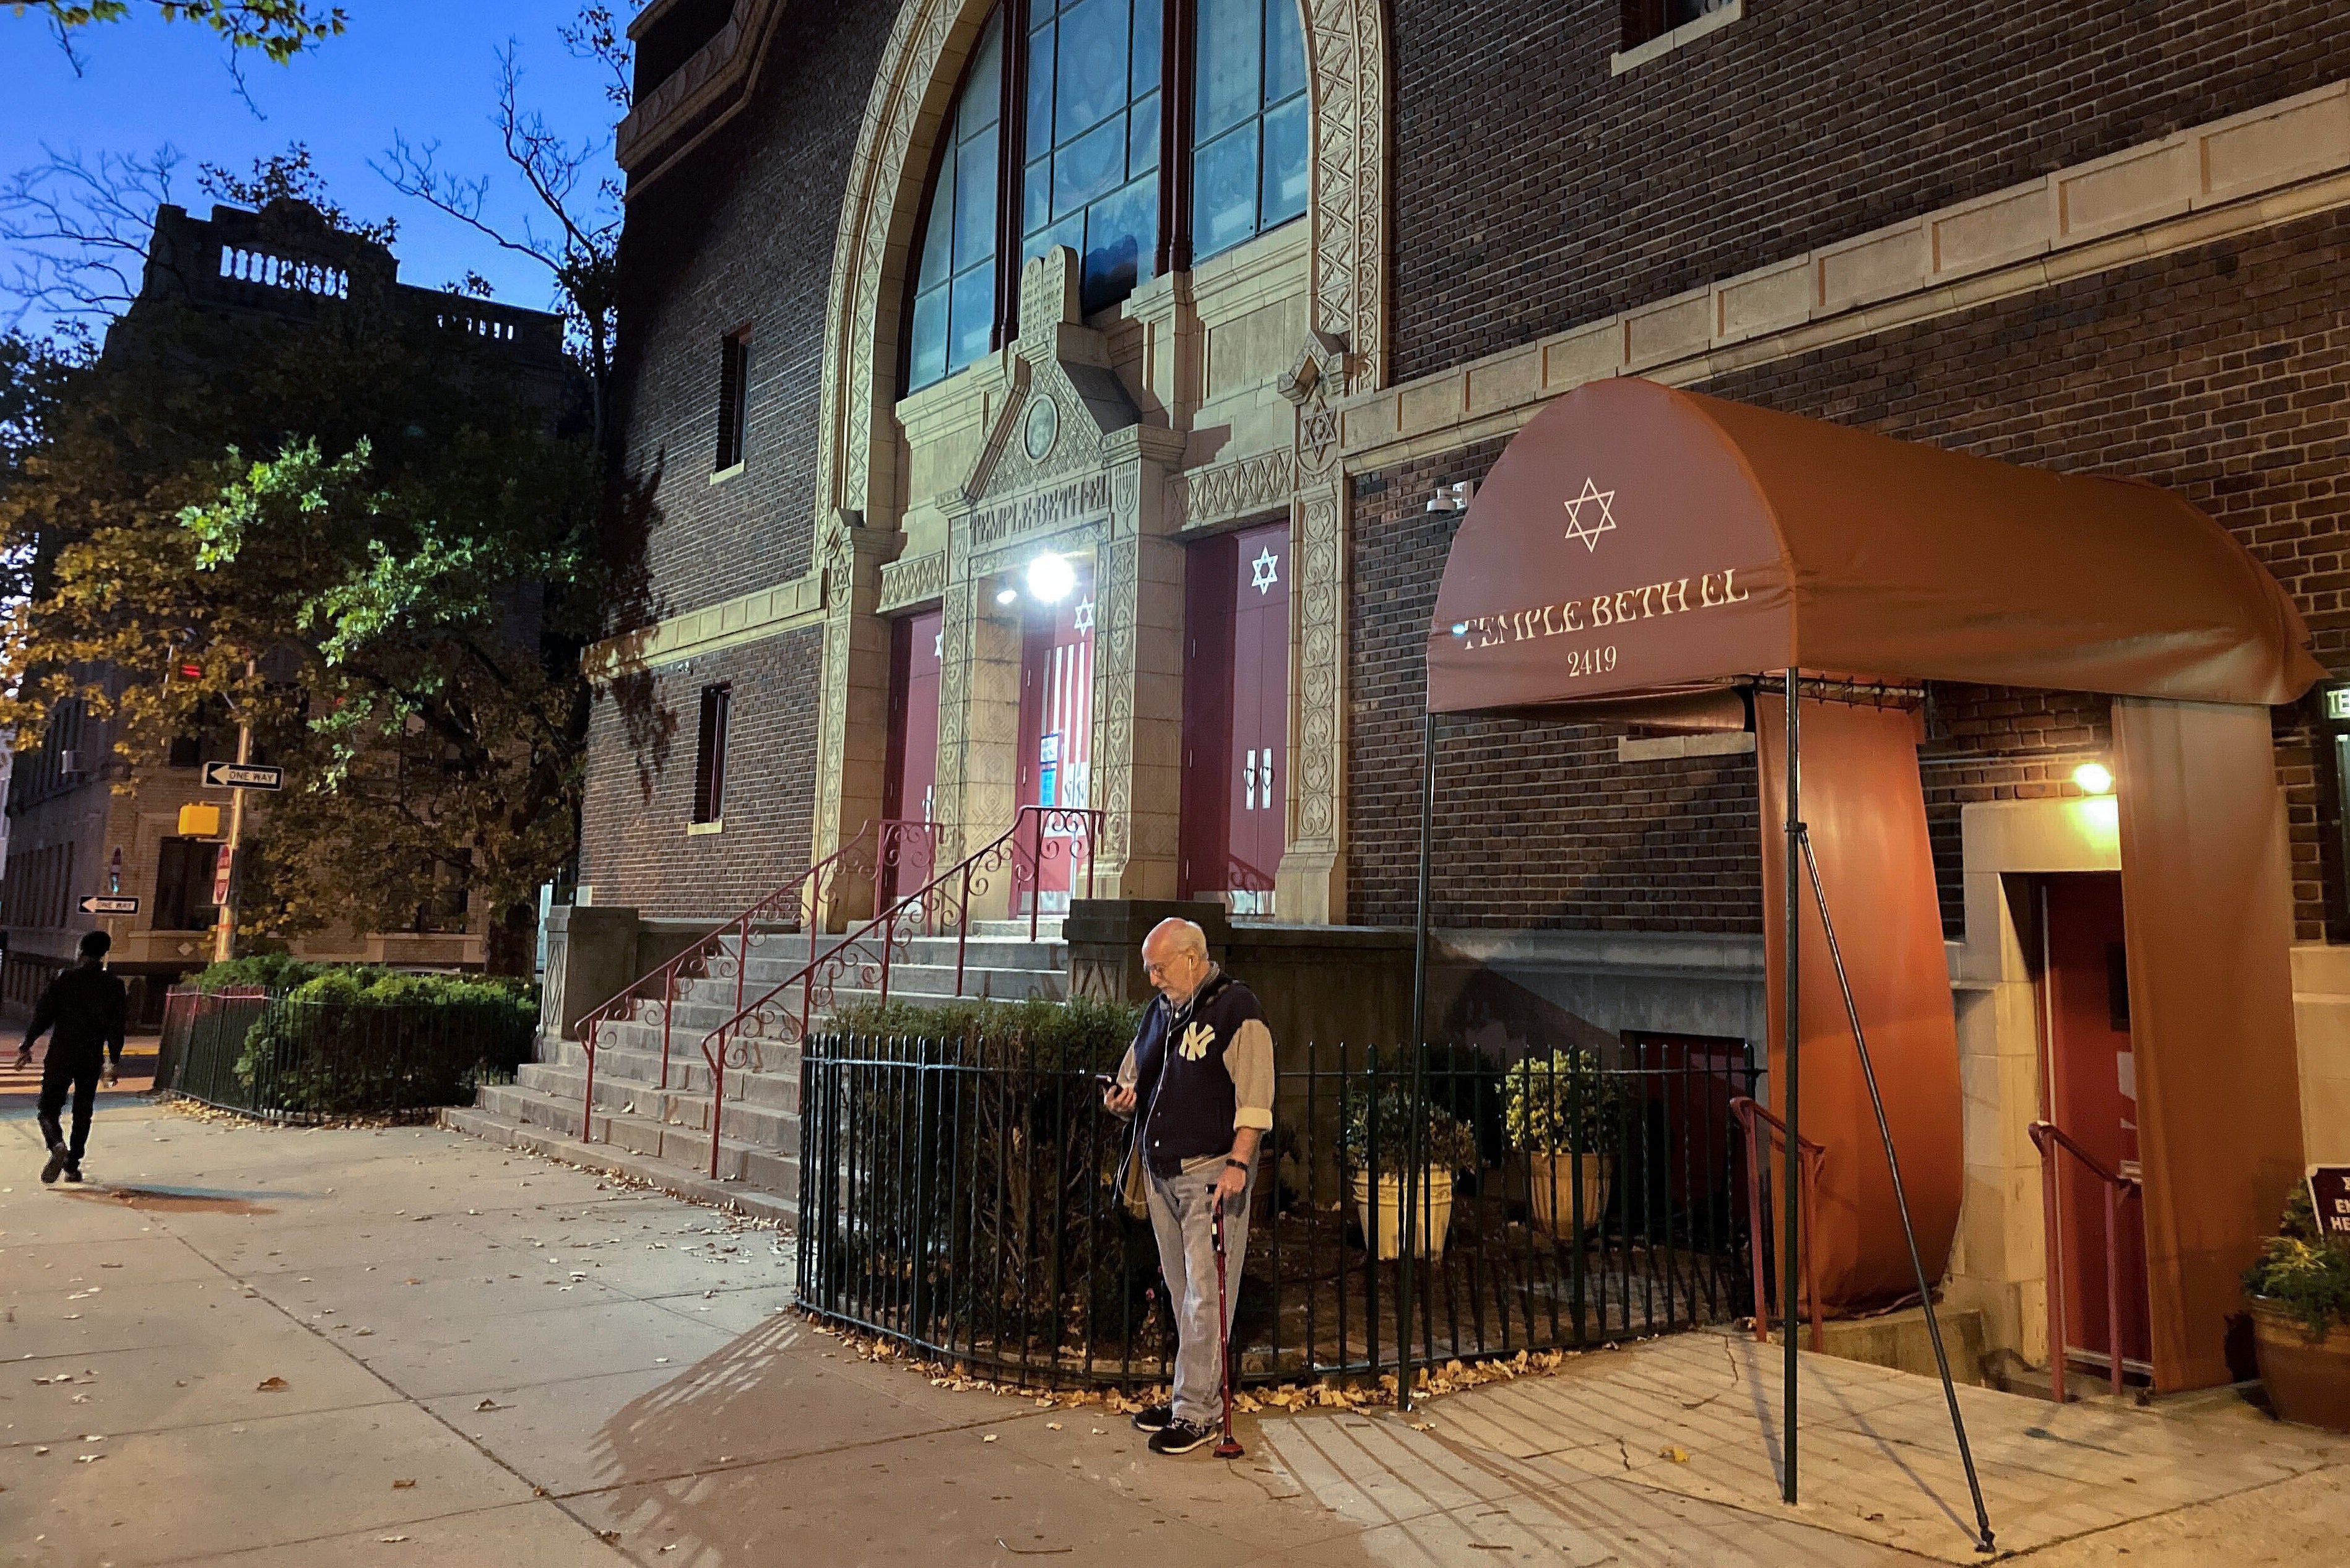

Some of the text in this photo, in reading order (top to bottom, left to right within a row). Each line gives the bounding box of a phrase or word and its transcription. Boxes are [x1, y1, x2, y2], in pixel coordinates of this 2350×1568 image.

[1463, 568, 1749, 650] TEMPLE BETH EL
[1567, 646, 1618, 677] 2419
[229, 771, 274, 782] ONE WAY
[1179, 1021, 1215, 1061] NY
